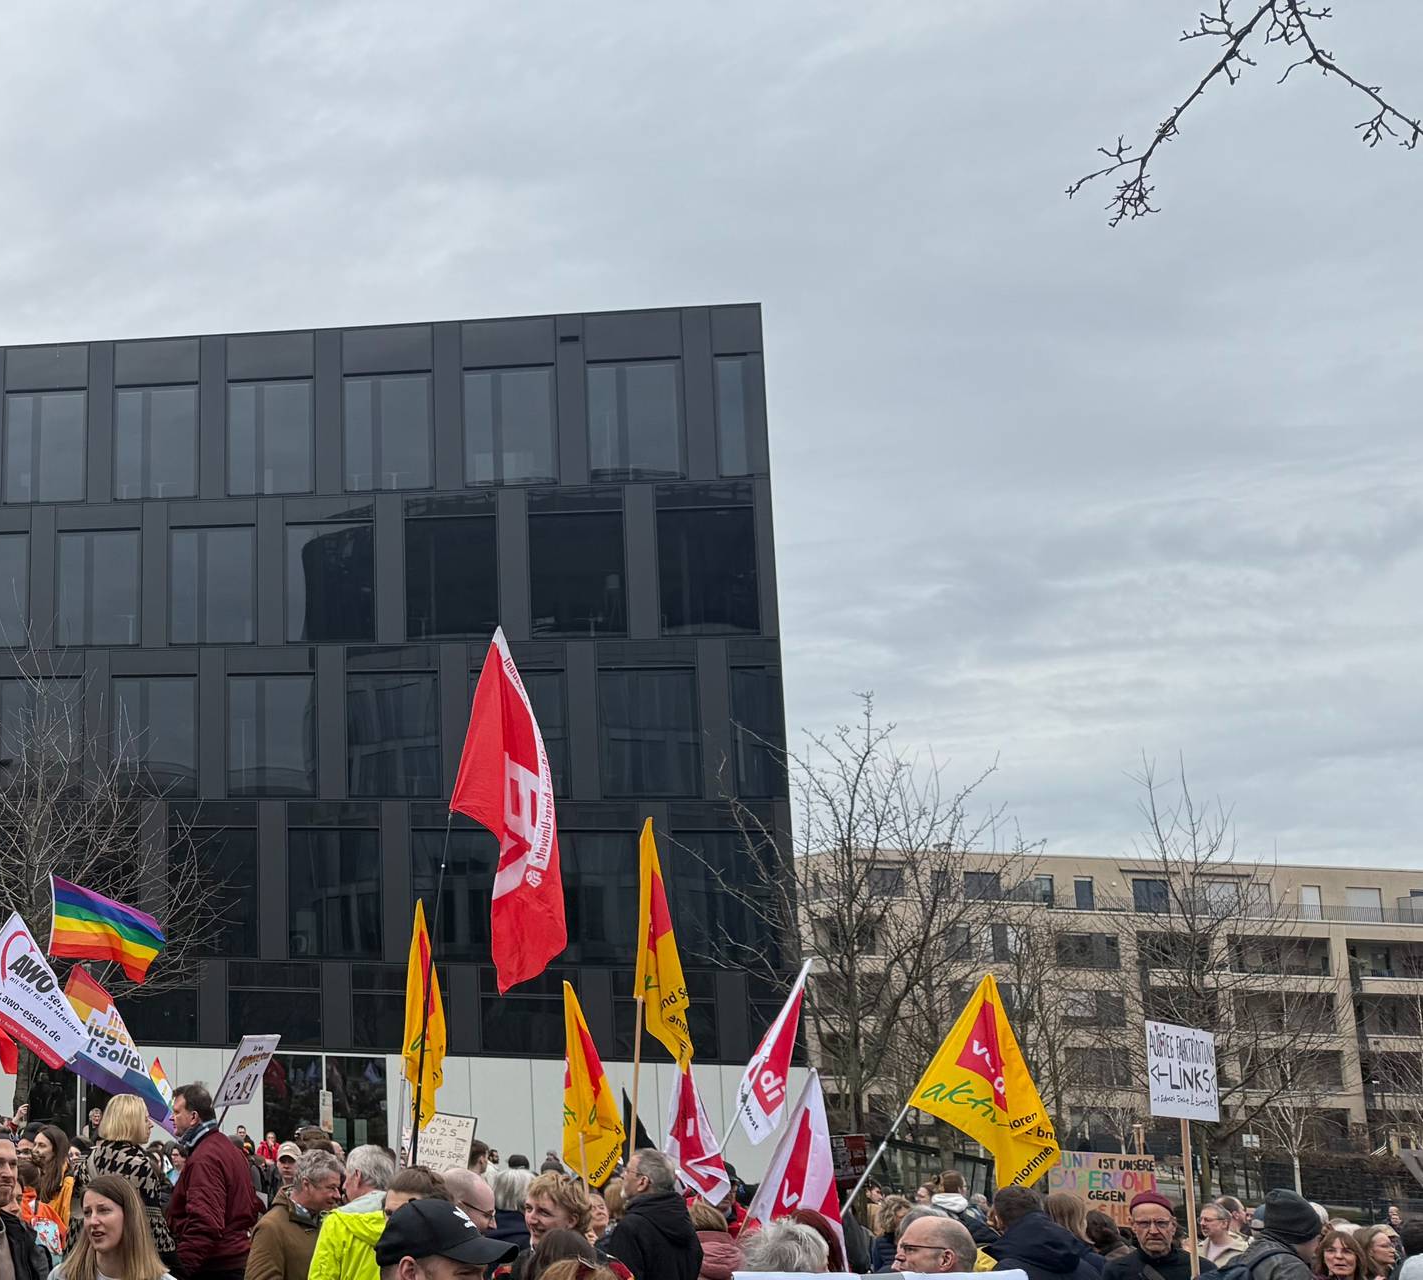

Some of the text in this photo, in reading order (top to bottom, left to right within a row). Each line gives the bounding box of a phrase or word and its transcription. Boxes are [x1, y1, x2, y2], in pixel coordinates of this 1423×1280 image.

[7, 953, 55, 994] AWO
[1098, 1157, 1116, 1170] IST
[1087, 1189, 1126, 1203] GEGEN
